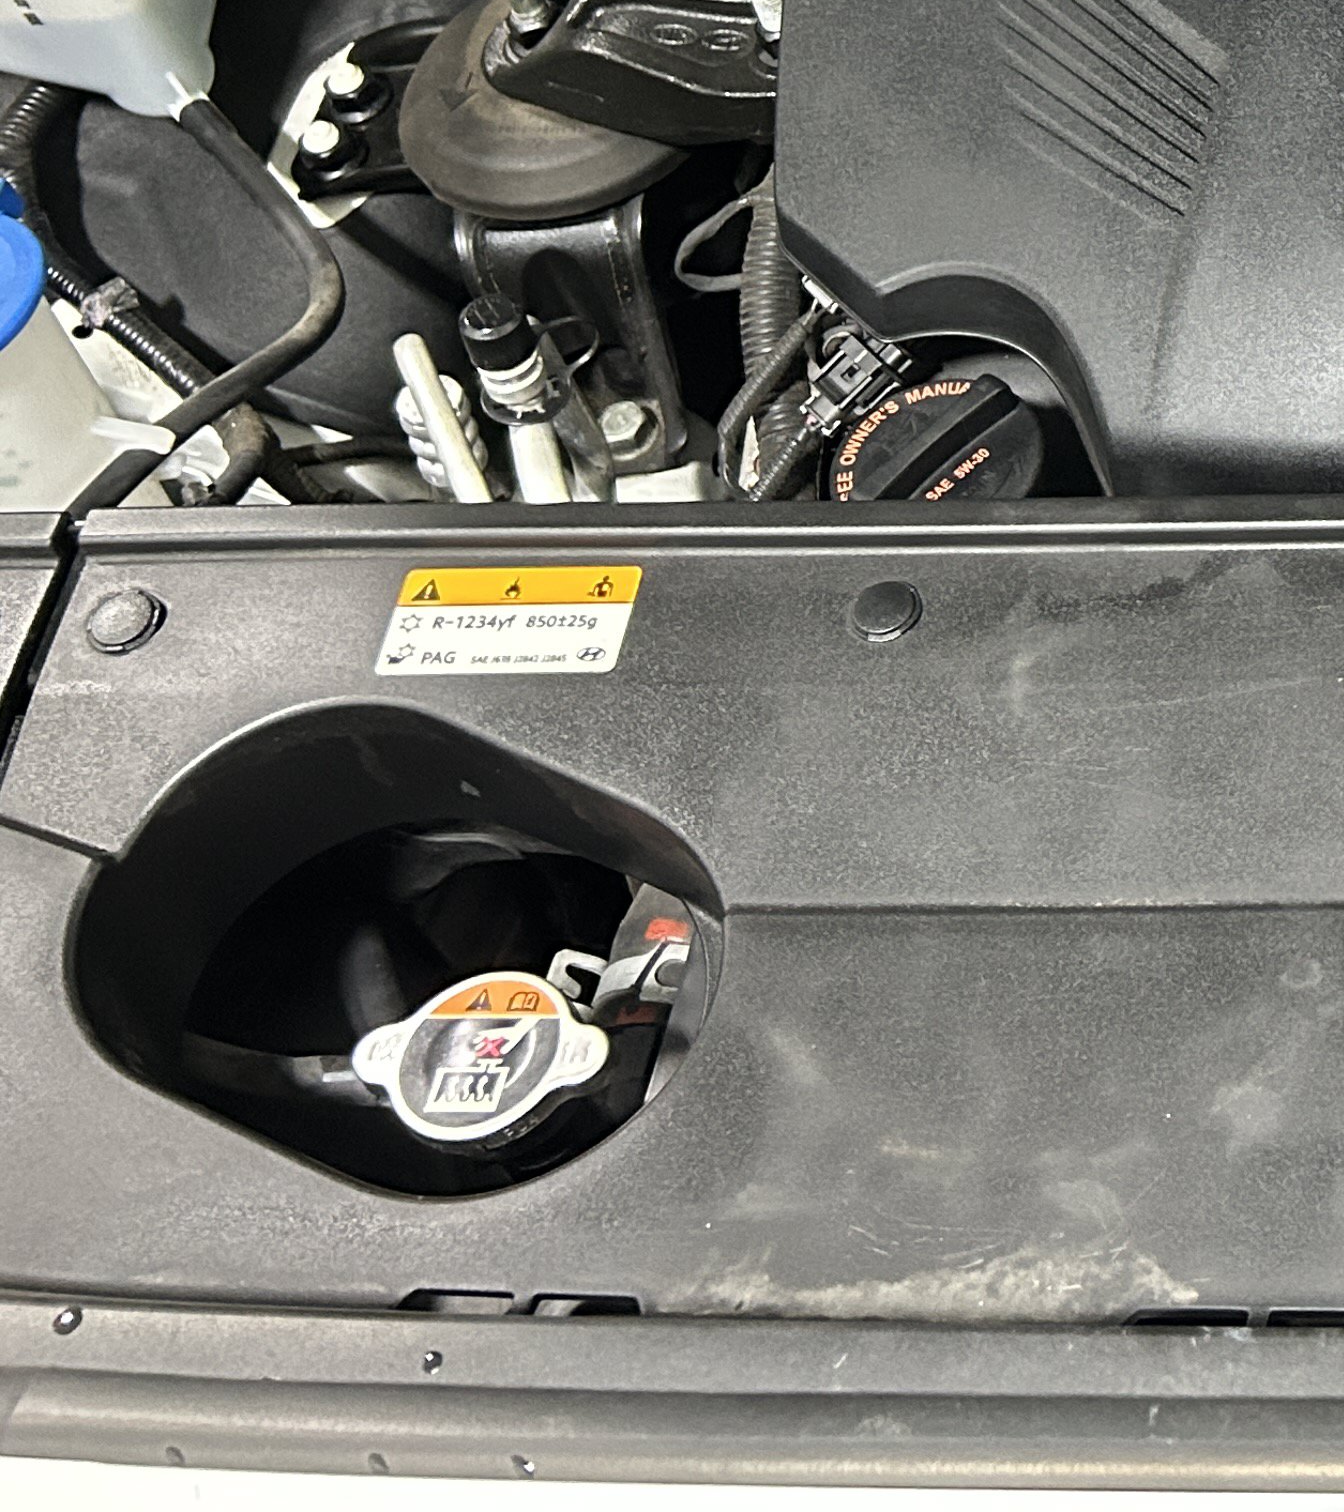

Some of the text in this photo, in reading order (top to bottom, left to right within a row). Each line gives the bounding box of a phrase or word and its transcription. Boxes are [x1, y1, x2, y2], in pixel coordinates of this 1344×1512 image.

[839, 399, 901, 467] OWNER'S
[904, 381, 972, 406] MANUA
[924, 446, 991, 502] SAE 5W-30
[431, 614, 599, 631] R-1234yf 850±25g
[420, 651, 457, 665] PAG
